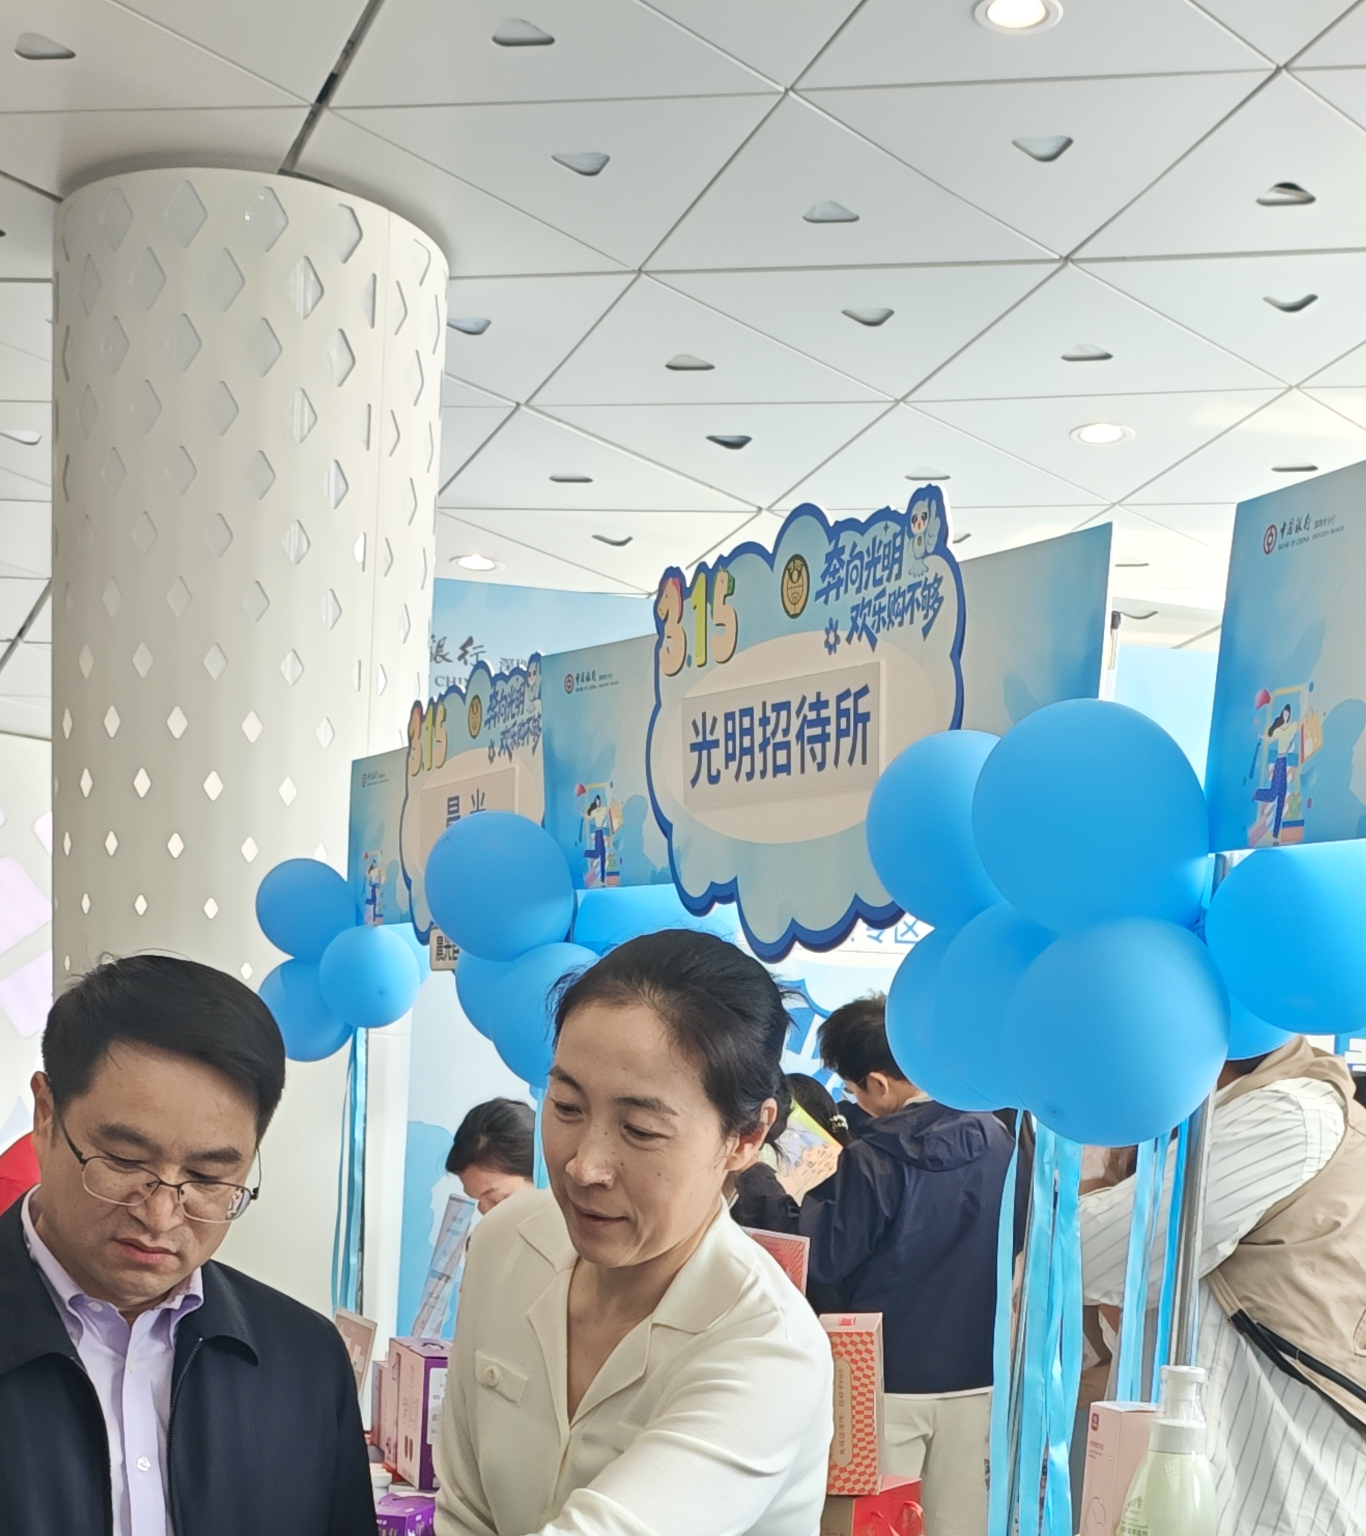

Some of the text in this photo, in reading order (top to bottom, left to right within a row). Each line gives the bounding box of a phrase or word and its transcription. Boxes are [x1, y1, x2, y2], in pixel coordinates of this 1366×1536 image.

[815, 531, 906, 605] 奔向光明
[845, 574, 944, 651] 欢乐购不够
[689, 683, 871, 789] 光明招待所
